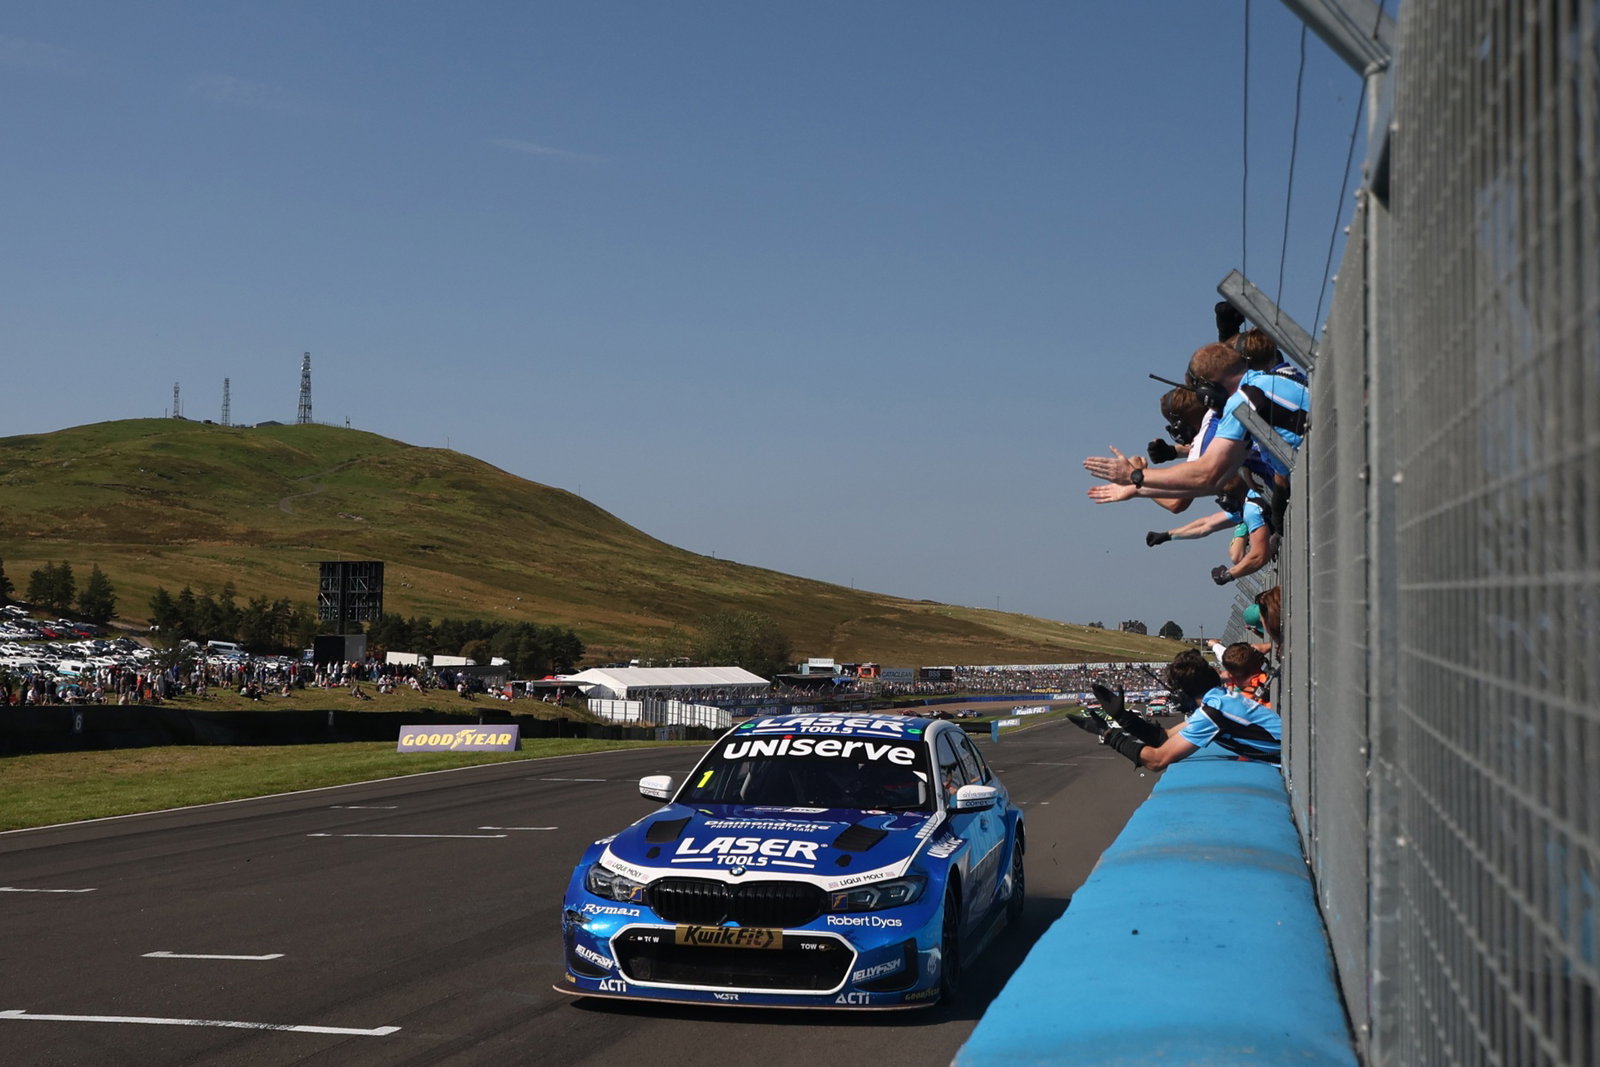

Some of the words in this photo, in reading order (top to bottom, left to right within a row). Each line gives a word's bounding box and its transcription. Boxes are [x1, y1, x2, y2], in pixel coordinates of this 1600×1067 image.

[74, 714, 82, 730] 6
[756, 716, 905, 733] LASER
[800, 725, 853, 735] TOOLS
[696, 770, 714, 788] 1
[675, 837, 820, 860] LASER
[716, 855, 768, 867] TOOLS
[611, 862, 628, 872] LIQUI
[627, 868, 643, 878] MOLY
[839, 877, 862, 887] LIQUI
[863, 872, 884, 882] MOLY
[581, 903, 641, 917] Ryman
[827, 915, 870, 927] Robert
[871, 916, 902, 929] Dyas
